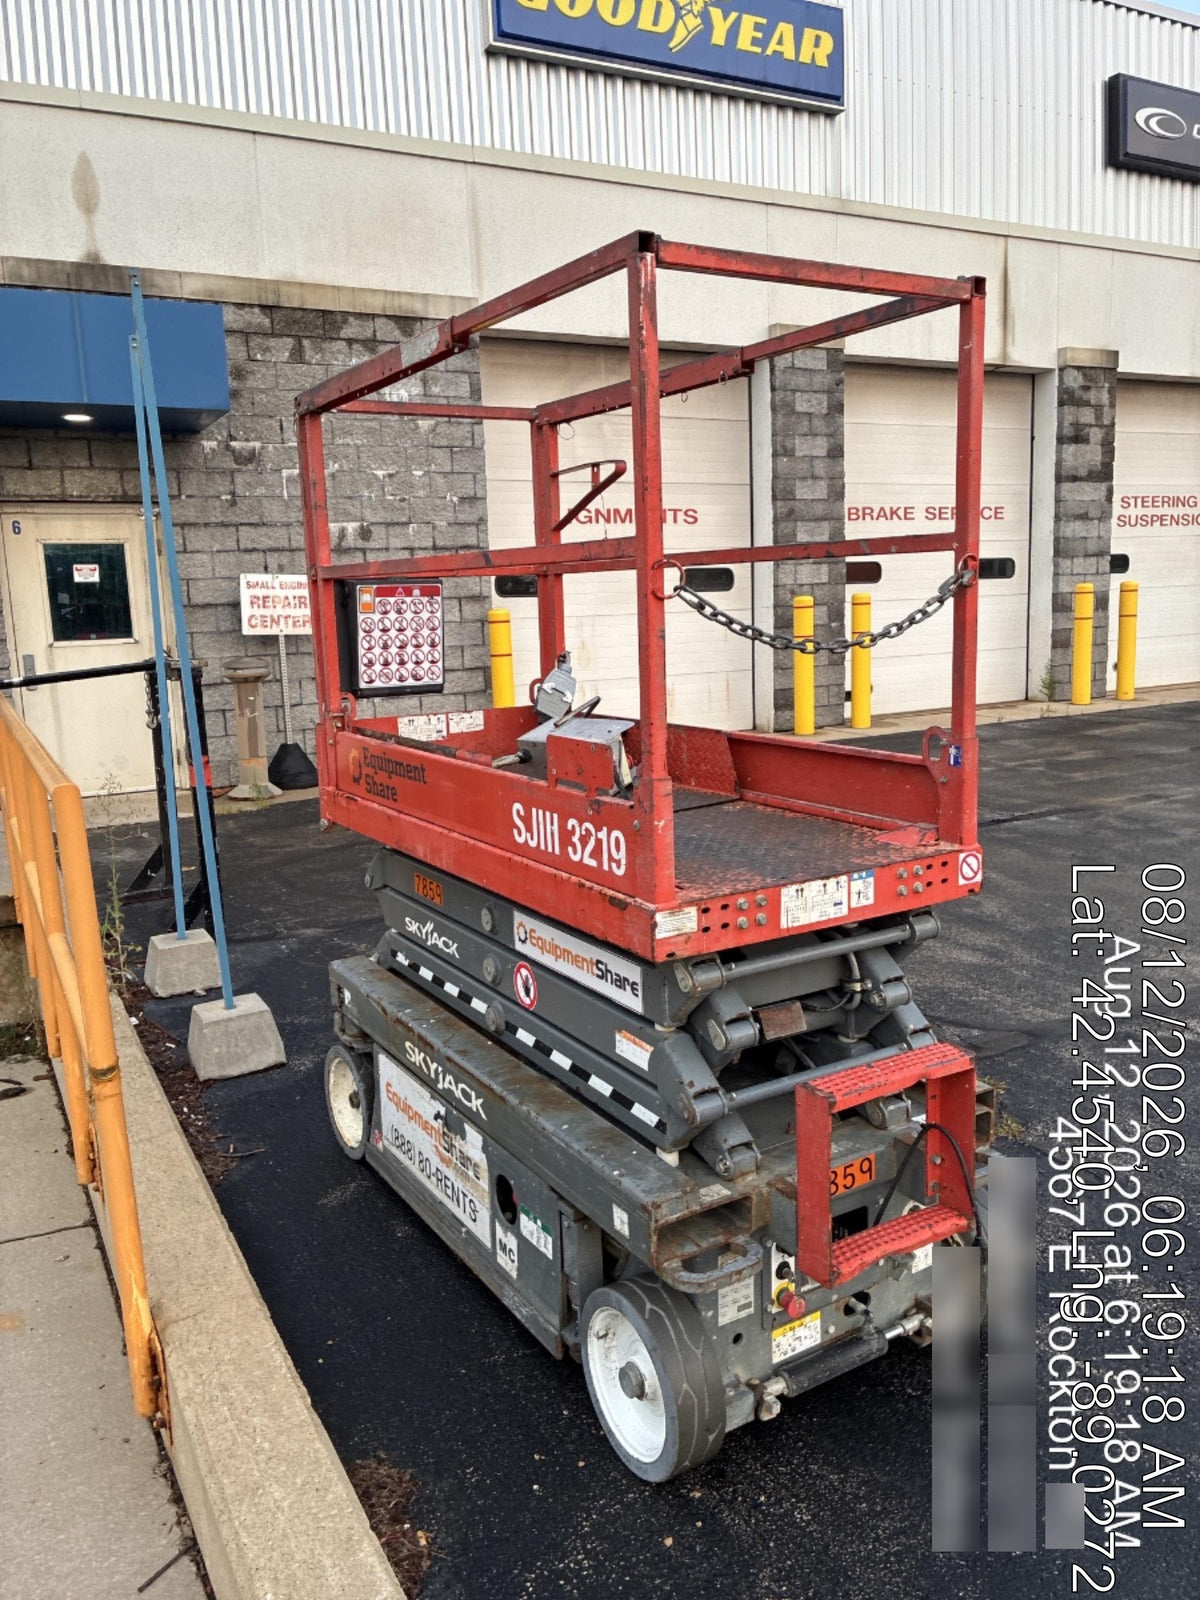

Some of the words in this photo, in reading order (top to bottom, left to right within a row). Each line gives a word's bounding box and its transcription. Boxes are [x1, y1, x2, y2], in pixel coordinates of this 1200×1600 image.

[847, 506, 915, 521] BRAKE
[1120, 495, 1198, 509] STEERING
[12, 520, 21, 535] 6
[246, 580, 276, 590] SMALL
[250, 595, 308, 609] REPAIR
[362, 746, 427, 785] Equipment
[365, 773, 398, 802] Share
[566, 818, 627, 877] 3219
[415, 874, 443, 905] 7859
[404, 916, 460, 959] SKYJACK
[528, 928, 640, 998] EquipmentShare
[404, 1040, 488, 1121] SKYJACK
[385, 1081, 481, 1182] EquipmentShare
[390, 1123, 416, 1166] (888)
[418, 1151, 478, 1224] 80-RENTS
[499, 1238, 516, 1263] MC
